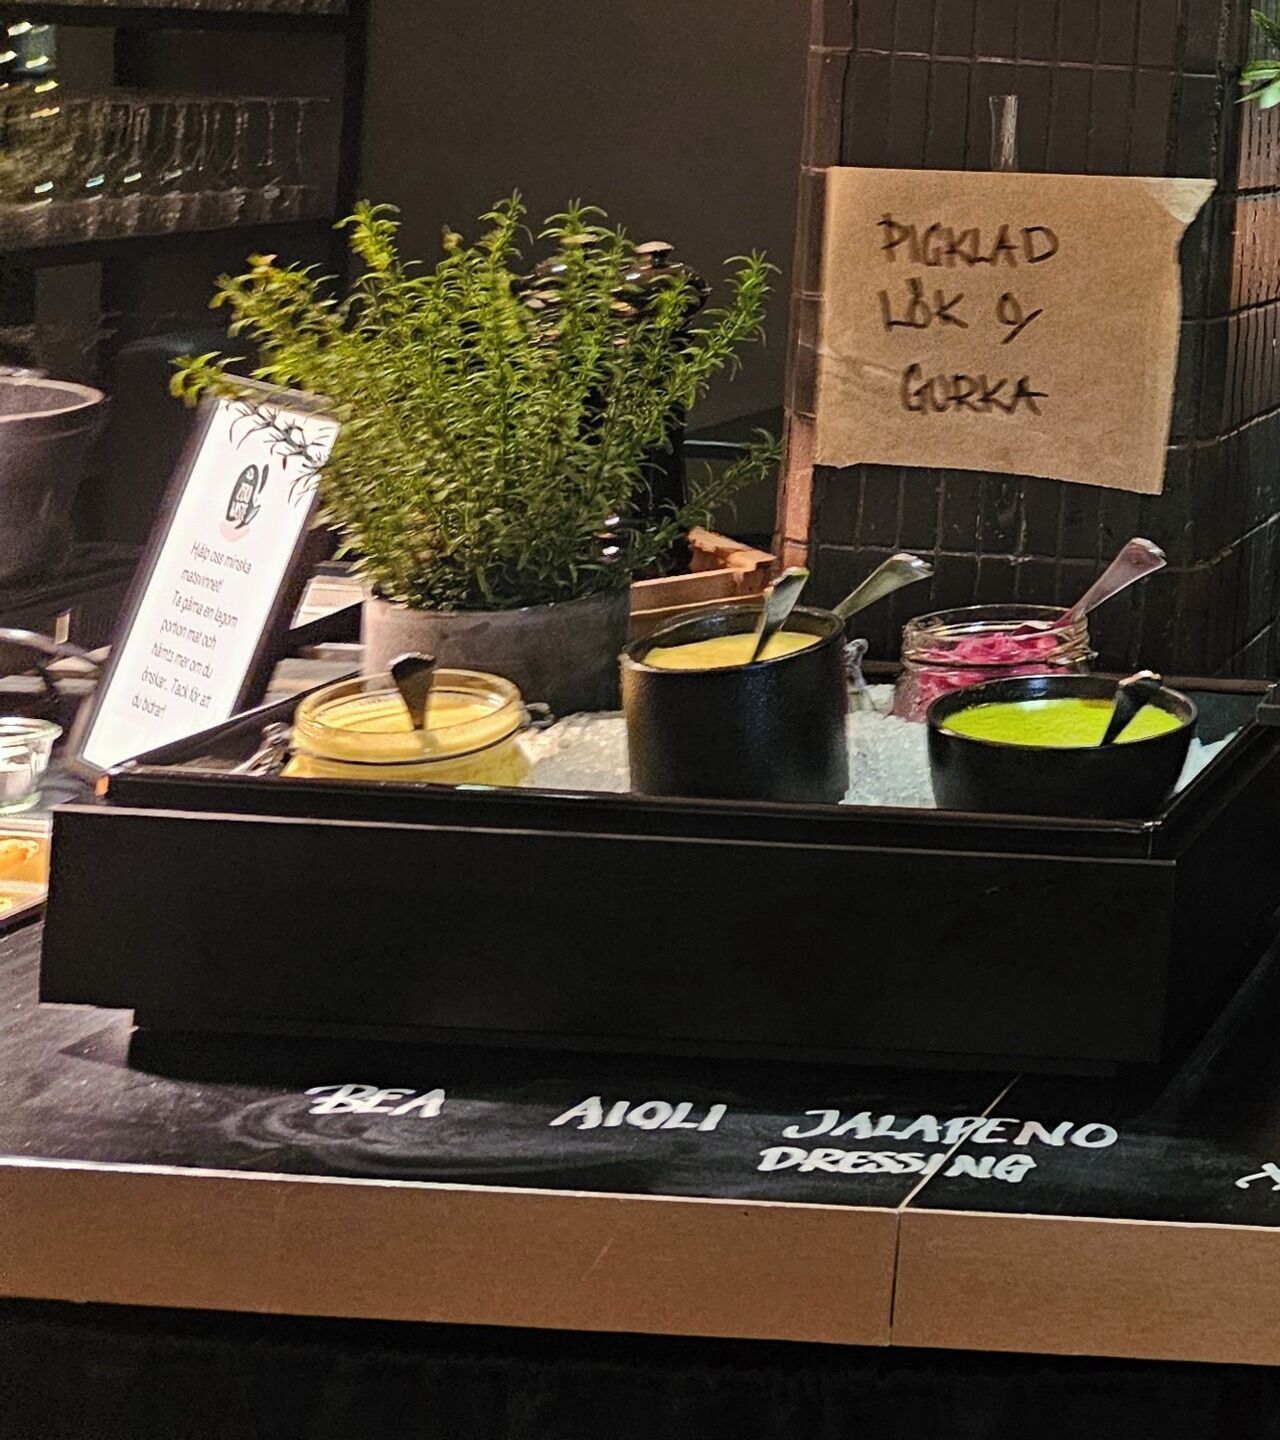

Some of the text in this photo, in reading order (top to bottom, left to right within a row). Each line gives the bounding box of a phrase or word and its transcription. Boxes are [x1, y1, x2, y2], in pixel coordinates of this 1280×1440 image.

[210, 551, 224, 565] oss
[173, 590, 182, 607] Ta
[203, 606, 214, 619] en
[214, 608, 238, 628] lagom
[186, 629, 202, 644] mat
[201, 635, 216, 649] och
[174, 654, 190, 668] mer
[189, 660, 202, 673] om
[202, 664, 213, 679] du
[171, 678, 189, 699] Tack
[132, 695, 142, 708] du
[304, 1083, 446, 1118] BEA
[549, 1095, 728, 1132] AIOLI
[757, 1146, 1037, 1183] DRESSING
